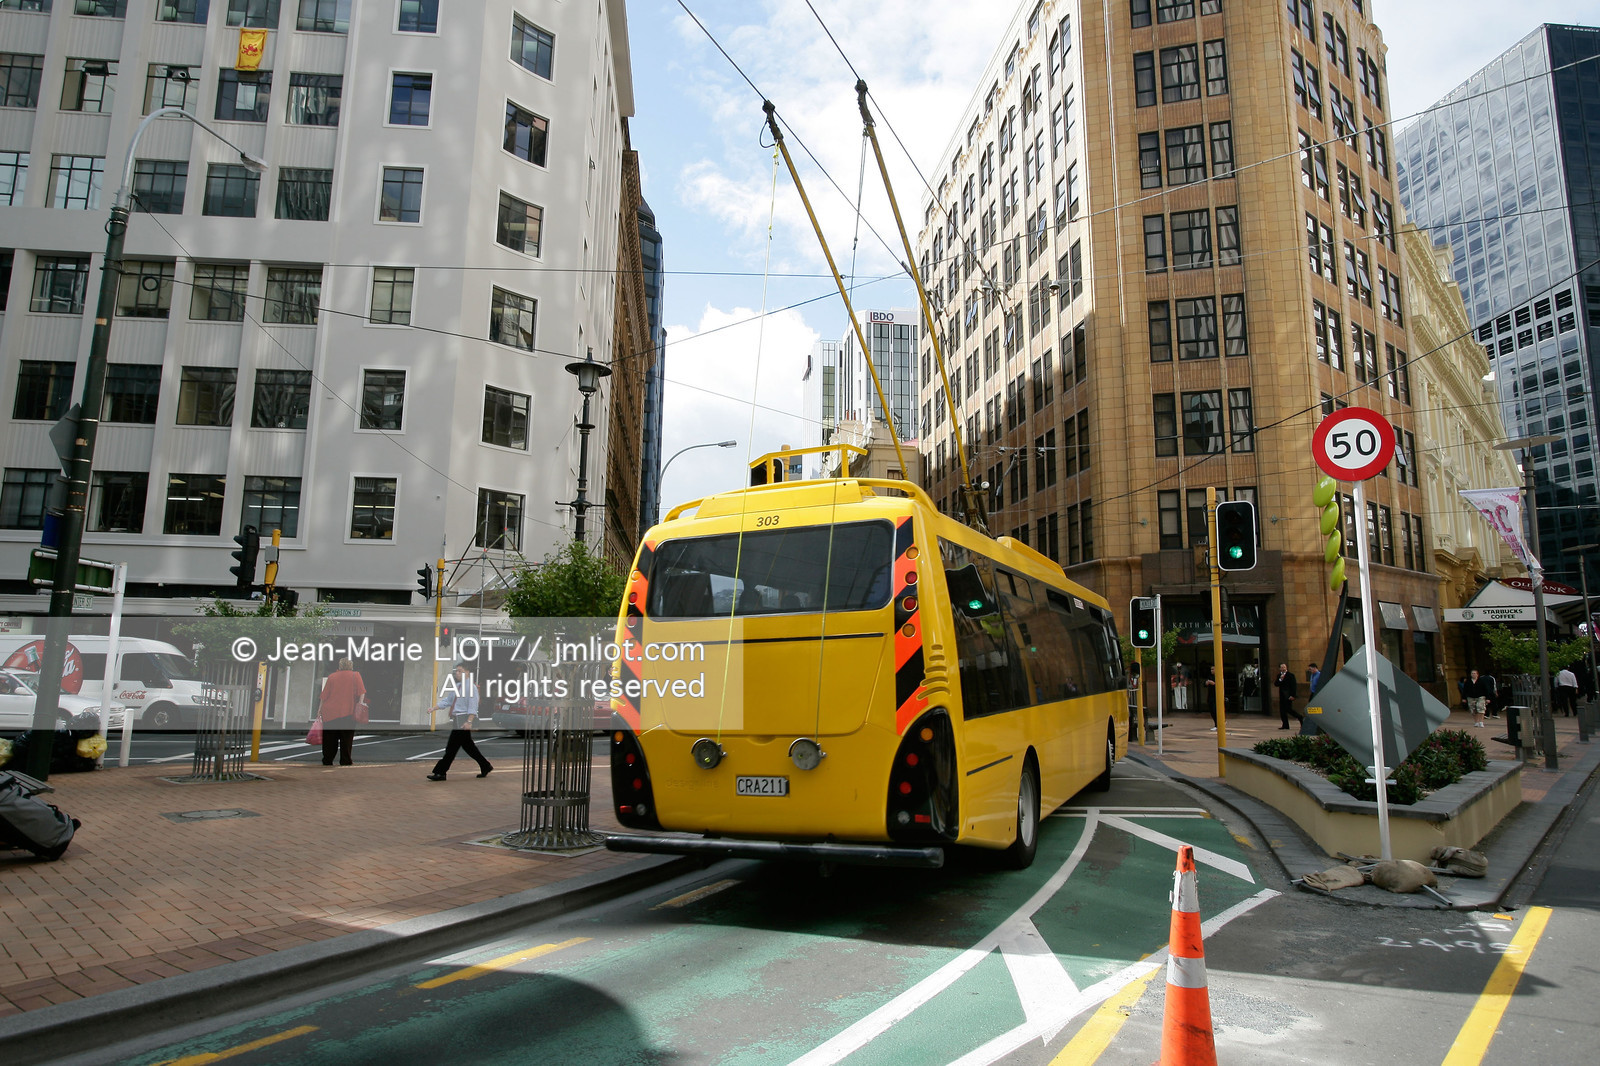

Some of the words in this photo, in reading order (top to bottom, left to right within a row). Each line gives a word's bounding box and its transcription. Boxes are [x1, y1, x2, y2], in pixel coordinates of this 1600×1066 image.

[872, 312, 894, 321] BDO
[1332, 429, 1376, 459] 50
[756, 515, 780, 527] 303
[737, 779, 783, 793] CRA211
